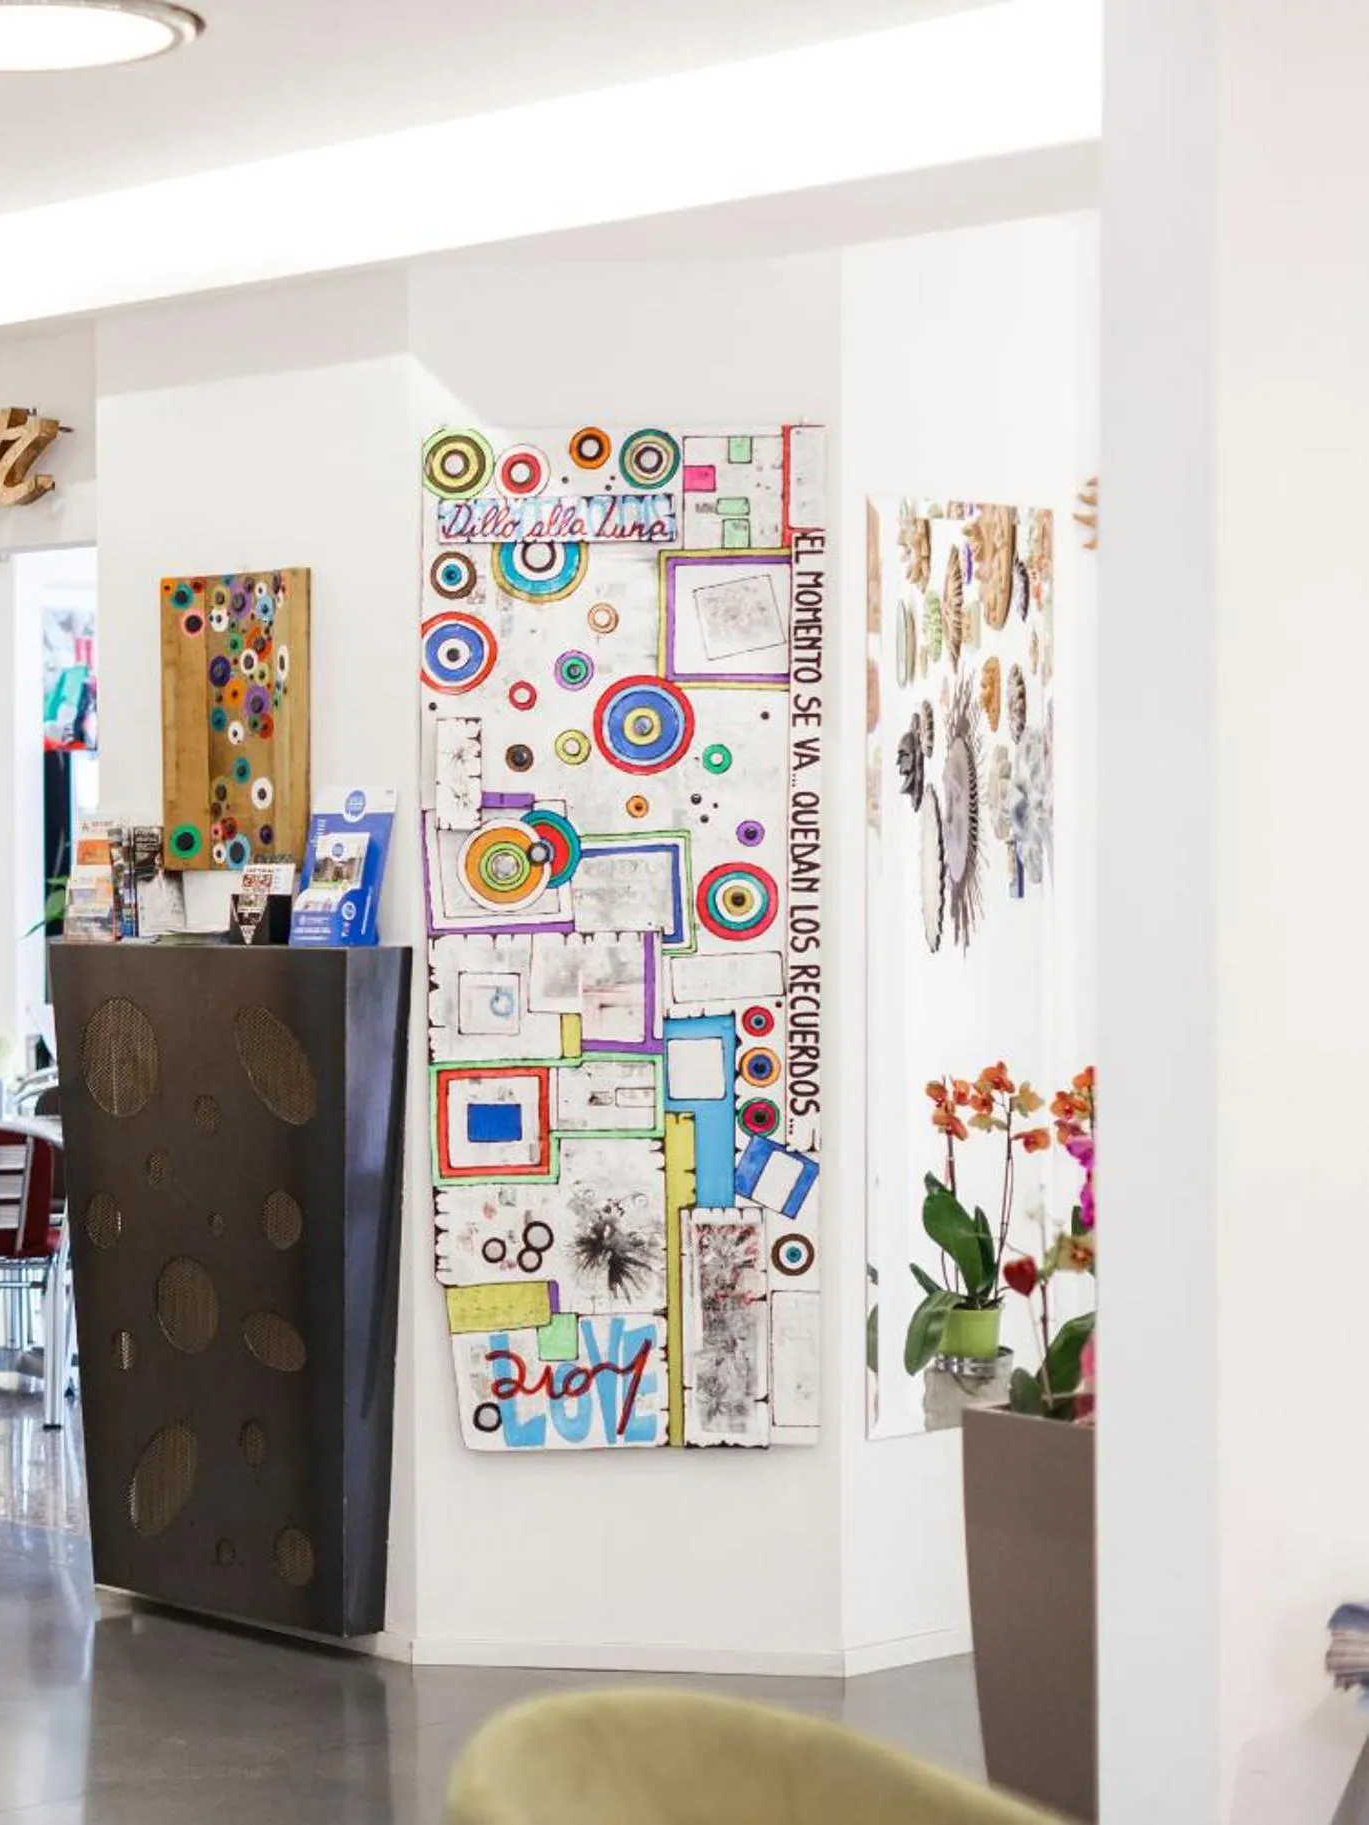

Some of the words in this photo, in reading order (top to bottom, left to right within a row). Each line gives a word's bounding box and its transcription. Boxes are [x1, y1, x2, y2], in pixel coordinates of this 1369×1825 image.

[794, 534, 825, 563] EL
[793, 571, 824, 684] MOMENTO
[792, 693, 822, 727] SE
[789, 904, 821, 953] LOS
